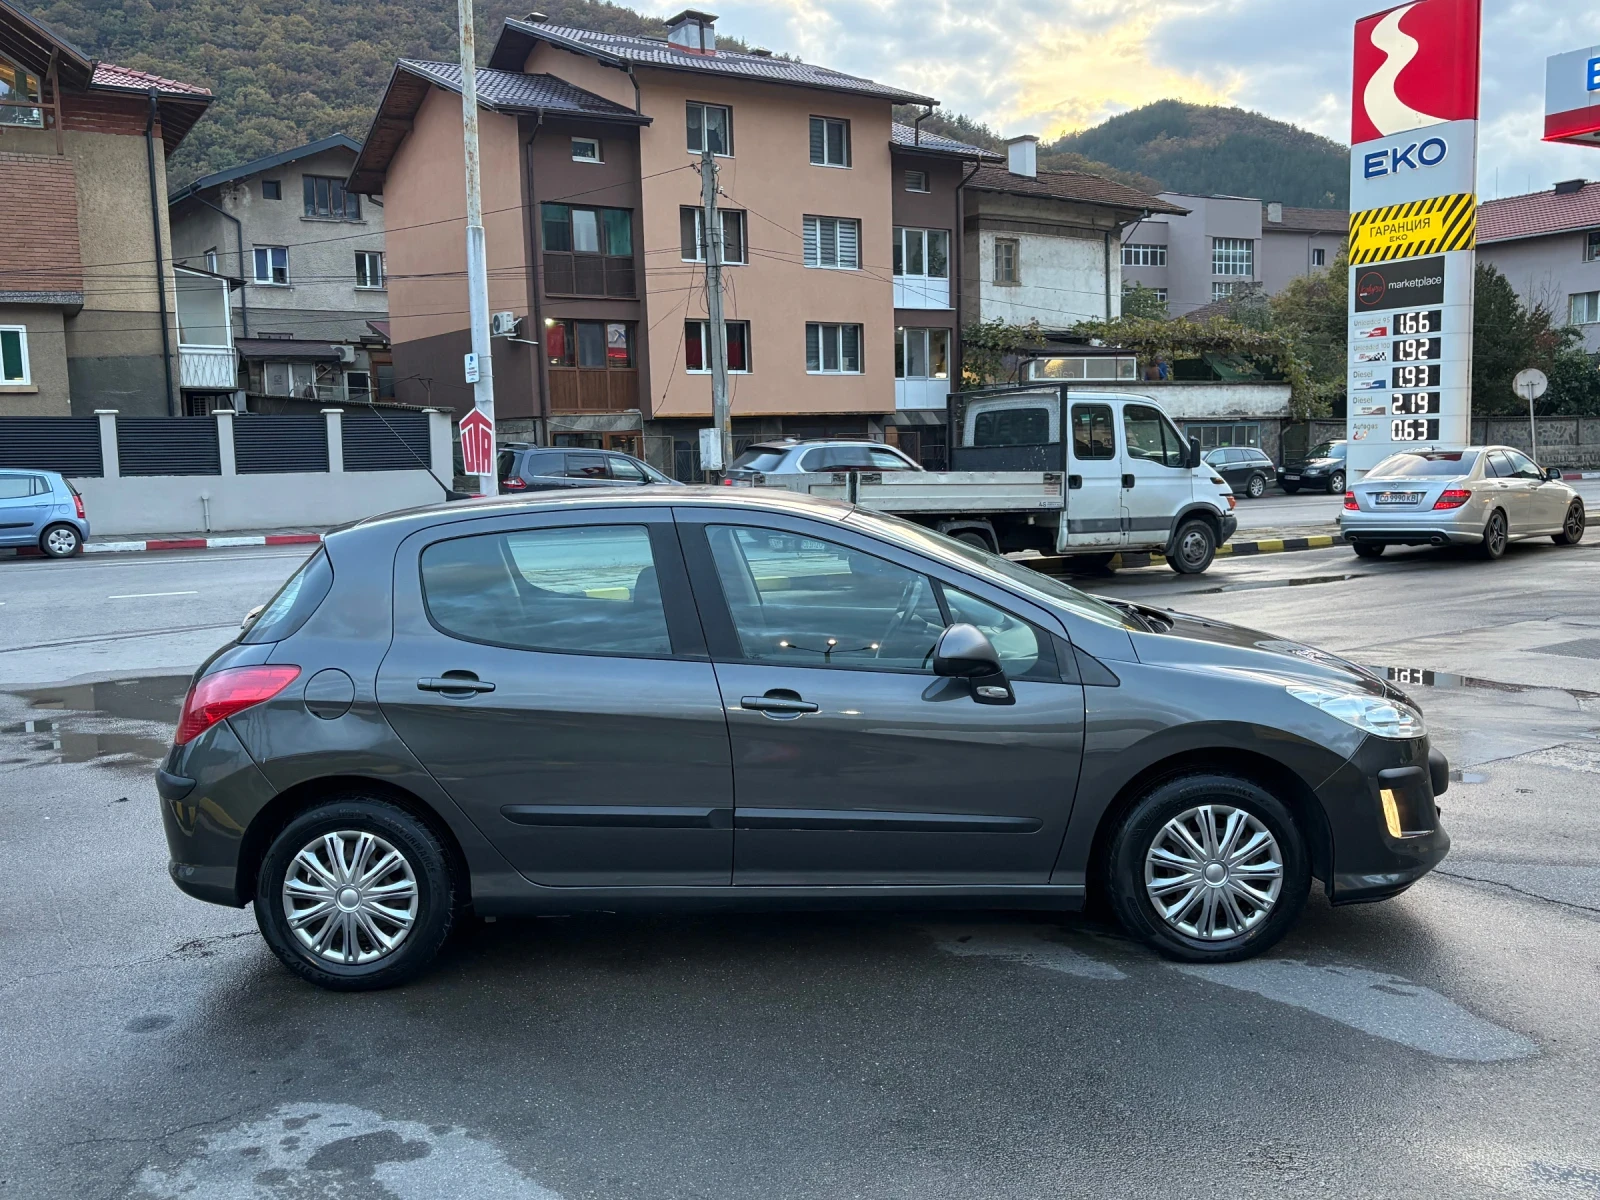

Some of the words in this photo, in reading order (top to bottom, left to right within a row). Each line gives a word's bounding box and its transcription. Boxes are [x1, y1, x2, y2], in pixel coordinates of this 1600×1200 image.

[1364, 137, 1448, 179] EKO
[1369, 217, 1430, 238] ГАРАНЦИЯ
[1388, 276, 1442, 289] marketplace
[1400, 311, 1430, 334] 1.66
[1399, 338, 1430, 361] 1.92
[1353, 370, 1373, 378] Diesel
[1399, 365, 1429, 387] 1.93
[1352, 396, 1373, 404] Diesel
[1392, 392, 1429, 414] 2.19
[1352, 423, 1378, 431] Autogas
[1391, 419, 1428, 441] 0.63
